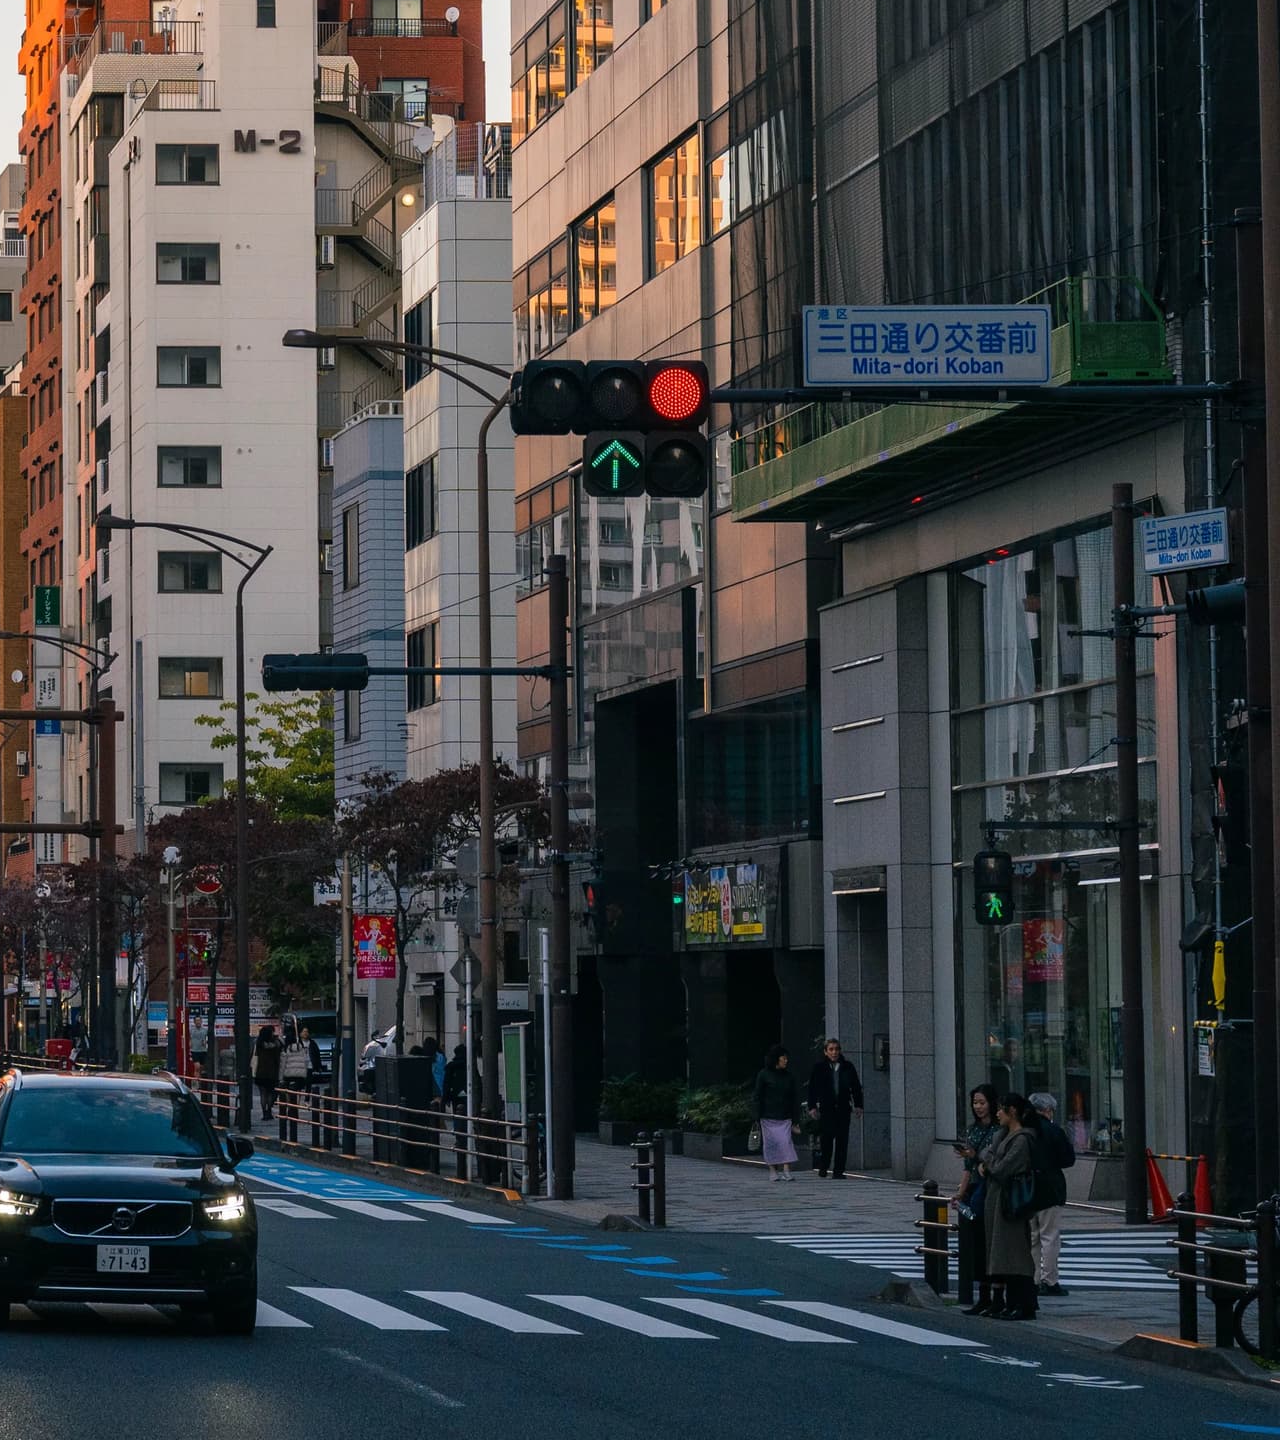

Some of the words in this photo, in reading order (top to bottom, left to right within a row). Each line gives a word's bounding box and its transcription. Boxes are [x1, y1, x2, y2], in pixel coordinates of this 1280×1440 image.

[233, 129, 302, 153] M-2
[817, 321, 1038, 355] 三田通り交番前
[852, 357, 939, 375] Mita-dori
[945, 357, 1004, 375] Koban
[1146, 520, 1223, 552] 三田通り交番前
[1191, 548, 1212, 560] Koban
[109, 1256, 146, 1270] 71-43
